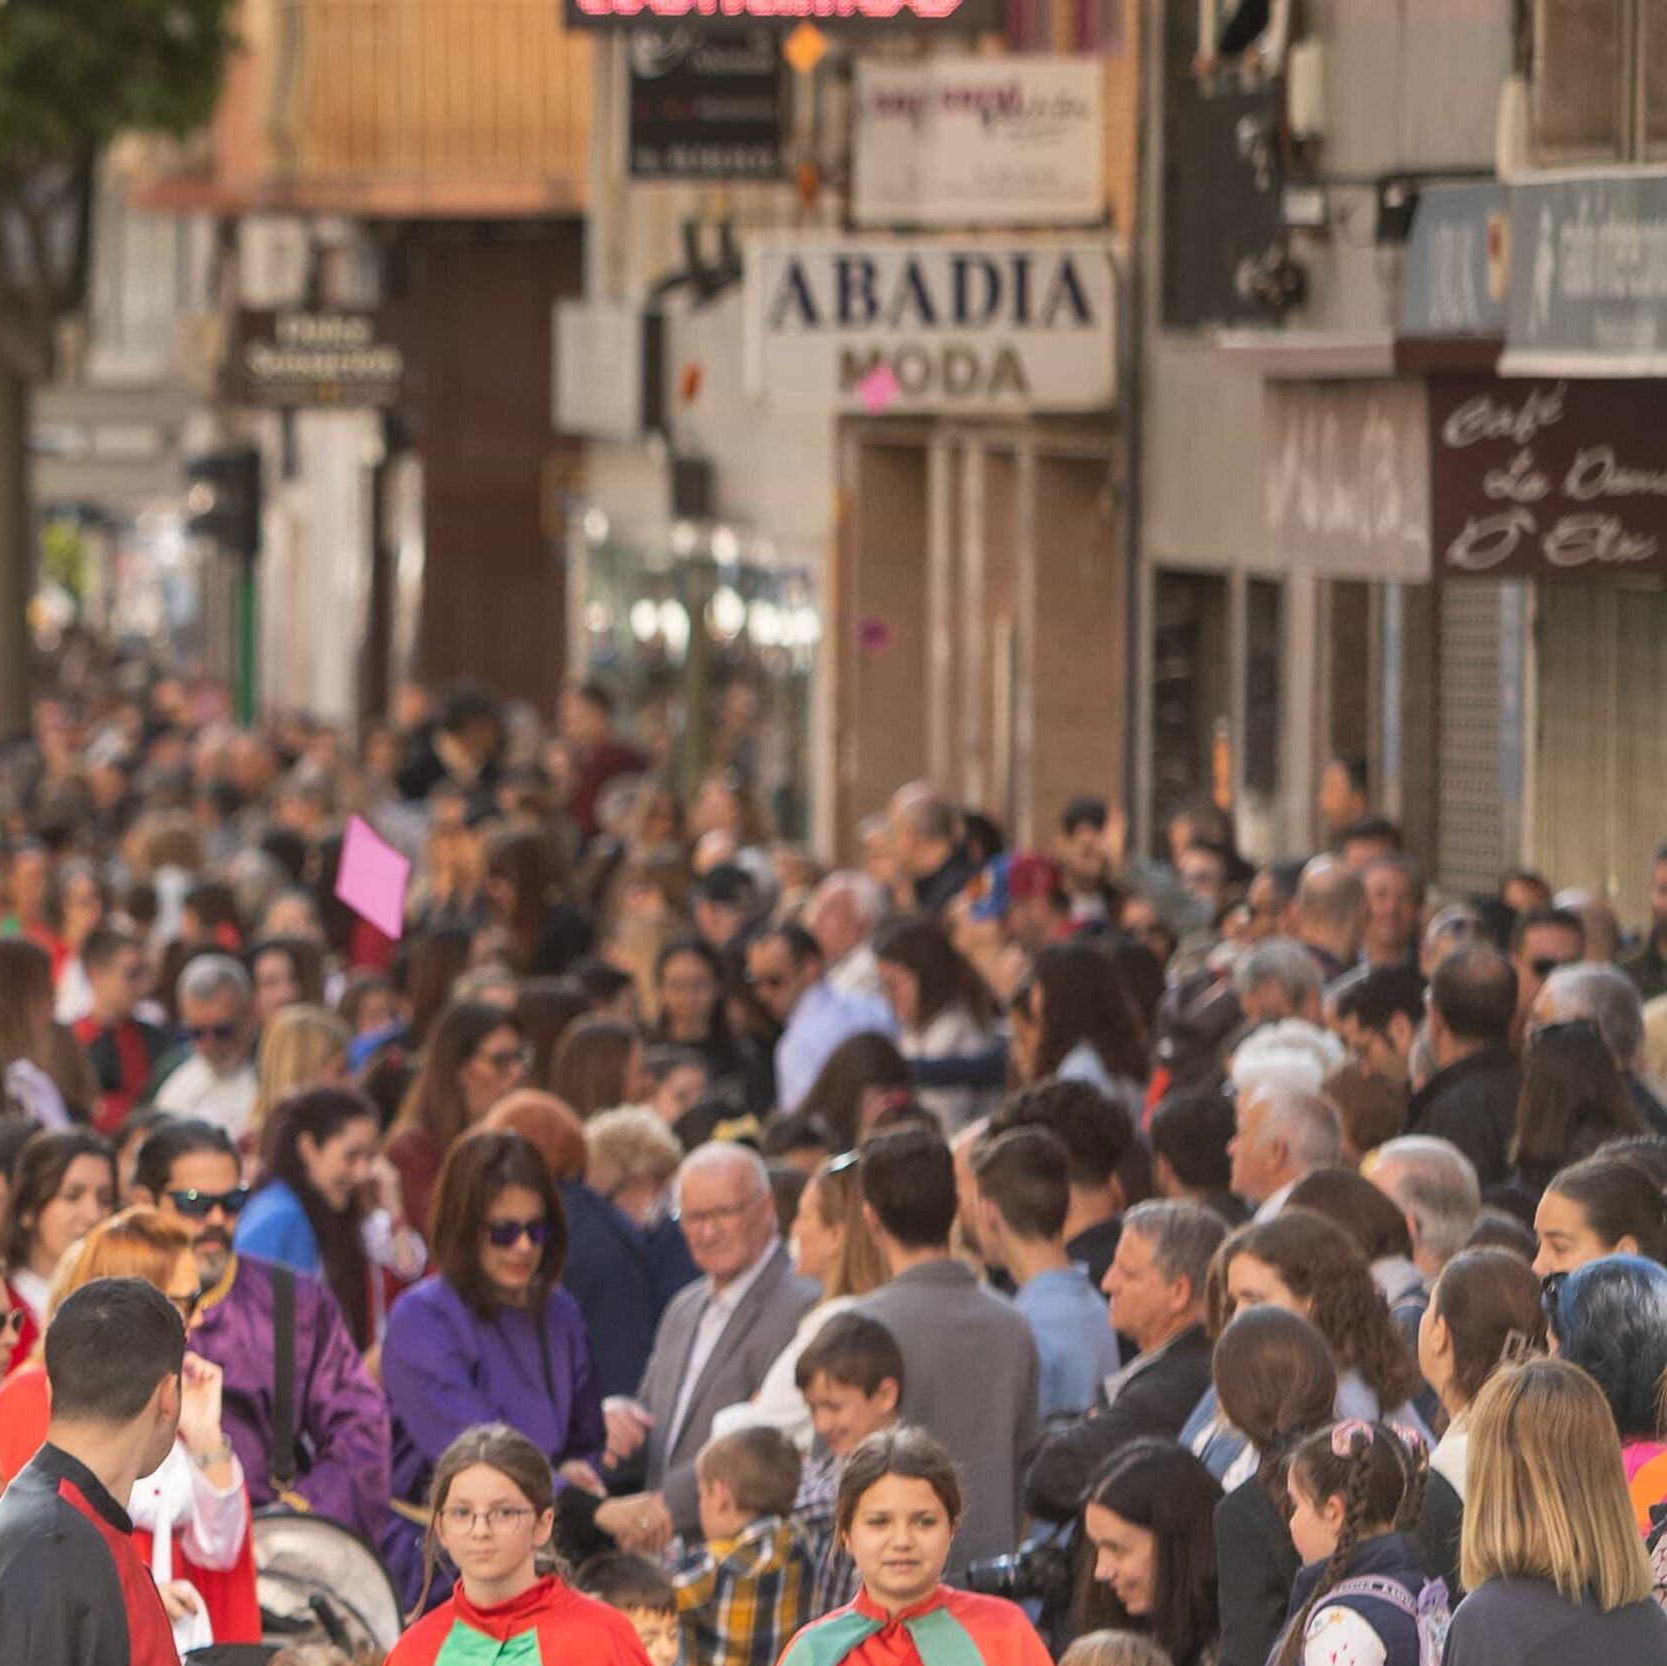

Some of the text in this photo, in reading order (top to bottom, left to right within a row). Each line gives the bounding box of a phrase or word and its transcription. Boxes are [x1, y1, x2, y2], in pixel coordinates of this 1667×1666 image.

[769, 254, 1094, 328] ABADIA
[837, 342, 1028, 397] MODA
[1443, 379, 1566, 447] Café
